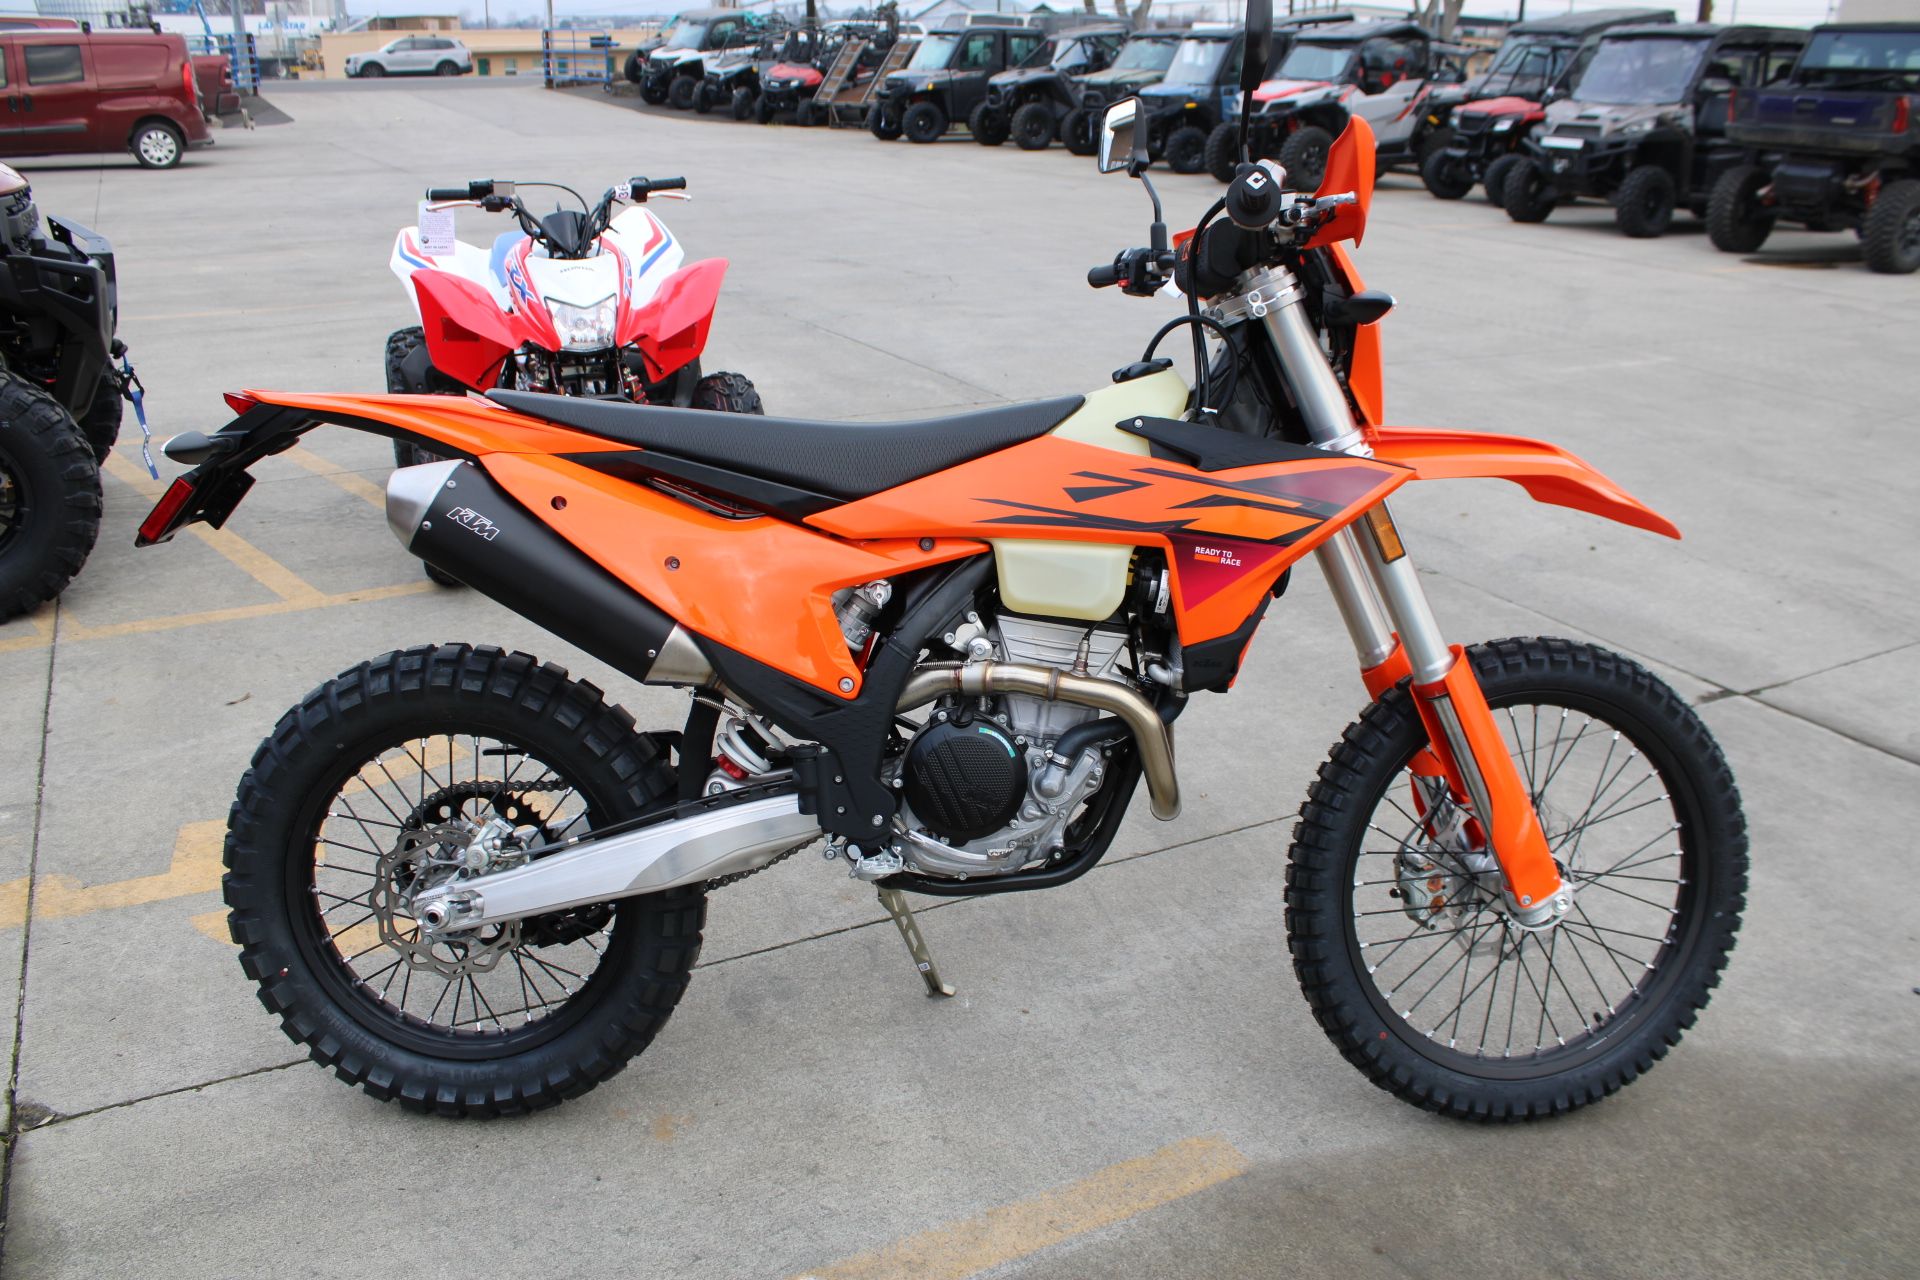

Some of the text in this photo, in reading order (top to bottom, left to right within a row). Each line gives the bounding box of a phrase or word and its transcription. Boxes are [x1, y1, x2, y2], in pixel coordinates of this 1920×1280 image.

[446, 506, 500, 541] KTM
[1195, 546, 1232, 558] READY TO
[1220, 557, 1241, 567] RACE
